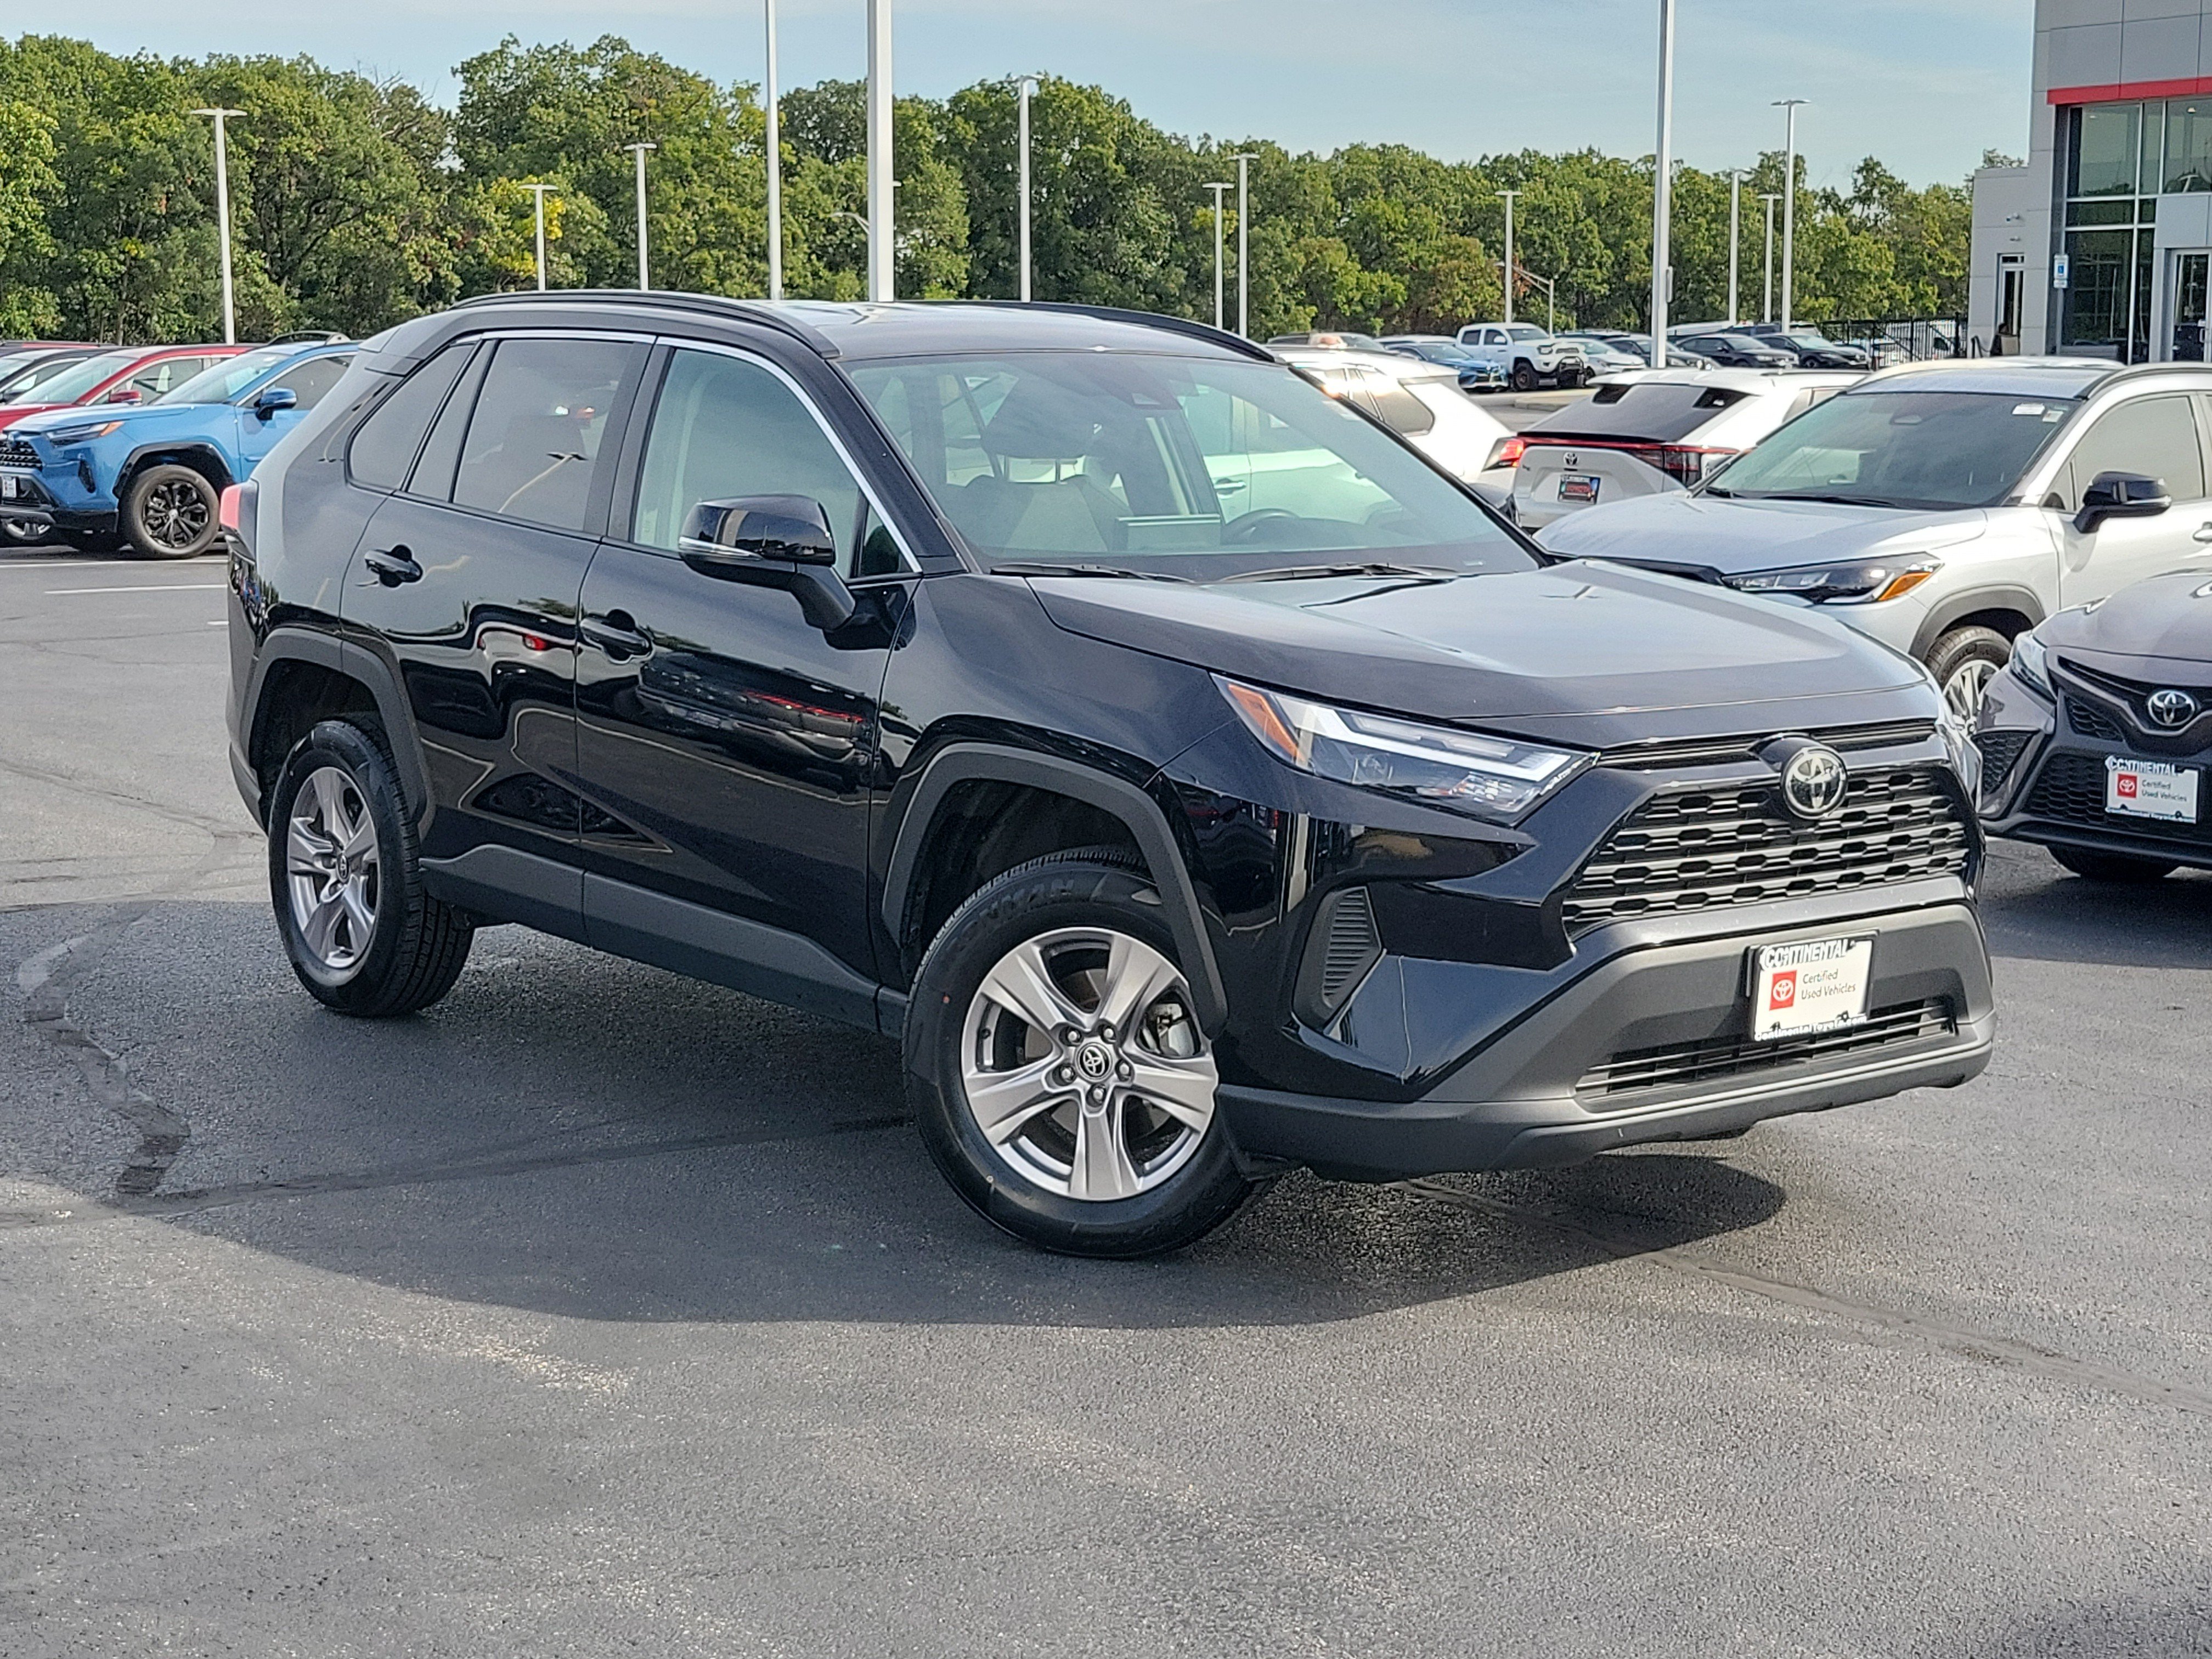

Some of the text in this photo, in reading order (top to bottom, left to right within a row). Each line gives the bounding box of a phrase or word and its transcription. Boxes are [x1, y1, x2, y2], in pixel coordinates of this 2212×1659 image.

[2142, 780, 2171, 789] Certified
[2142, 789, 2187, 802] Used Vehicles
[1759, 939, 1849, 970] CONTINENTAL
[1803, 969, 1838, 984] Certified
[1801, 982, 1856, 1000] Used Vehicles
